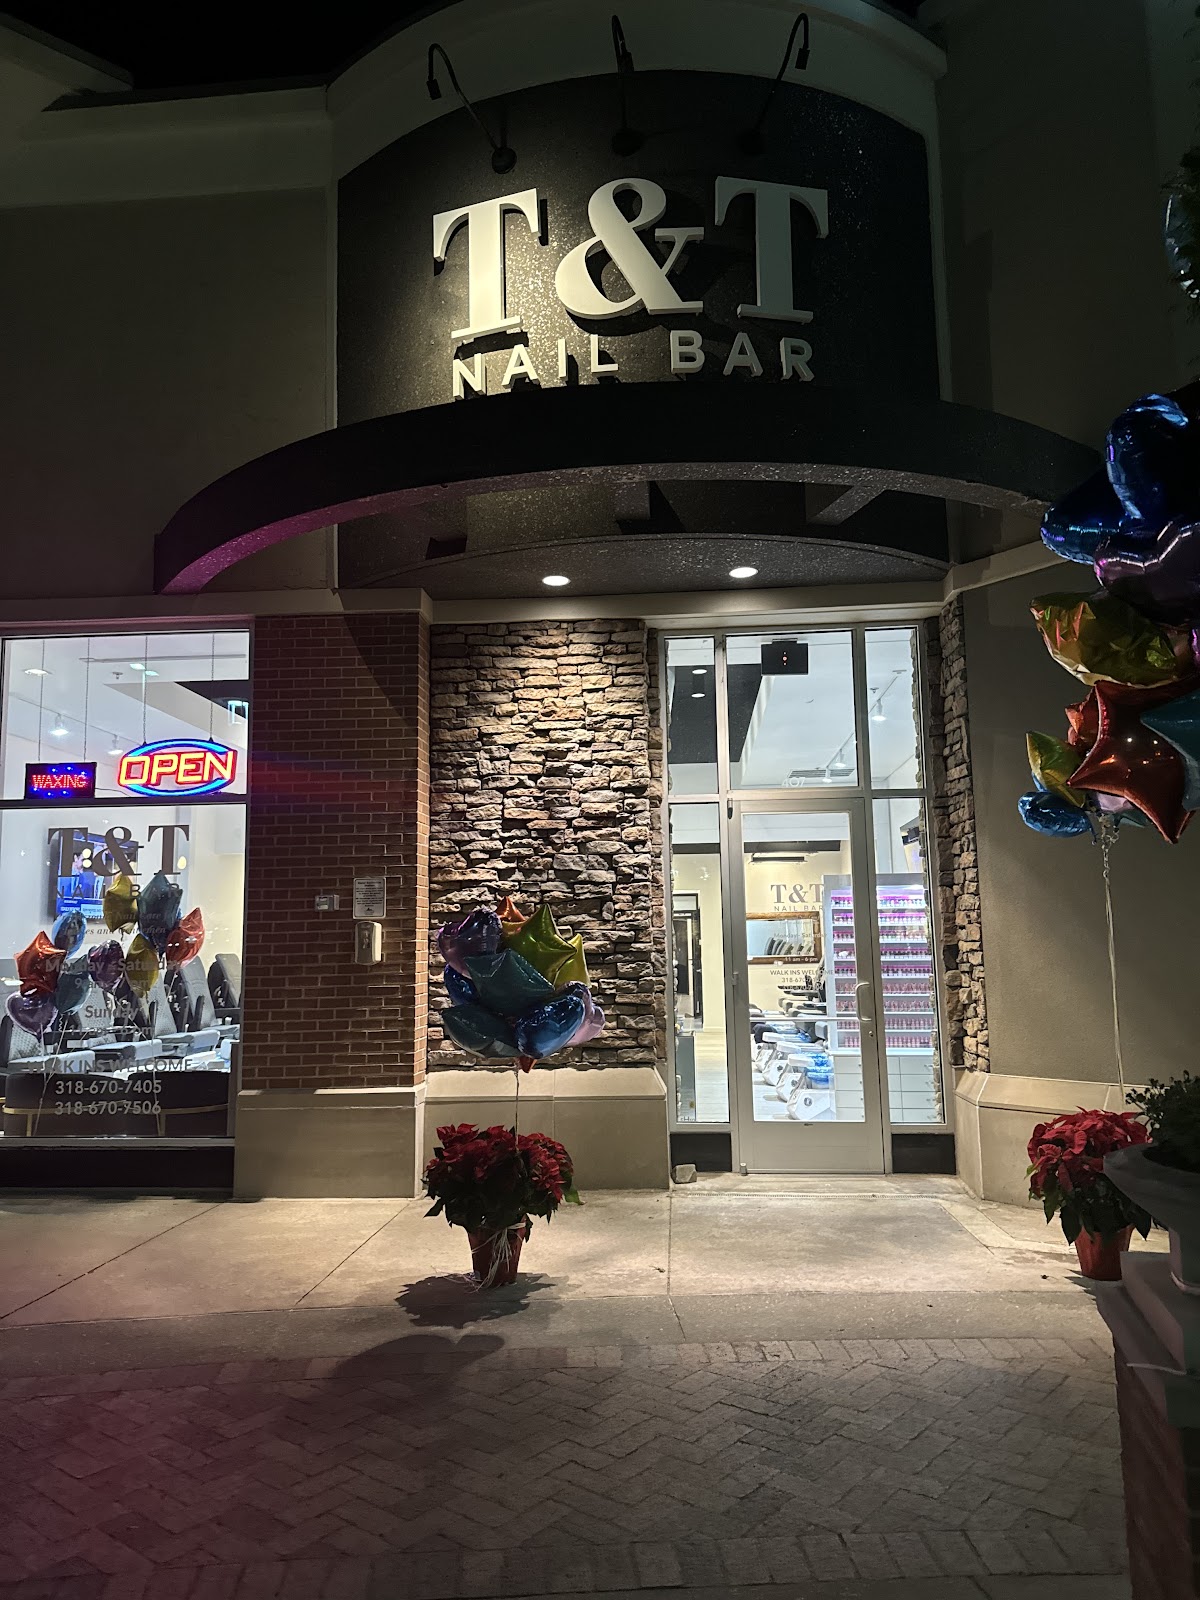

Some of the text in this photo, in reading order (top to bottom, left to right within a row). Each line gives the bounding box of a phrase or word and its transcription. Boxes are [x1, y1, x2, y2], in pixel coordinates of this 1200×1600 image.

[433, 176, 829, 340] T&T
[452, 330, 815, 399] NAIL BAR
[119, 750, 234, 787] OPEN
[32, 774, 88, 789] WAXING
[782, 777, 806, 788] 407
[48, 824, 190, 878] T&T
[131, 882, 180, 899] BAR
[45, 958, 105, 977] Monday
[84, 1004, 139, 1022] Sunday
[55, 1080, 162, 1095] 318-670-7405
[54, 1101, 162, 1116] 318-670-7506
